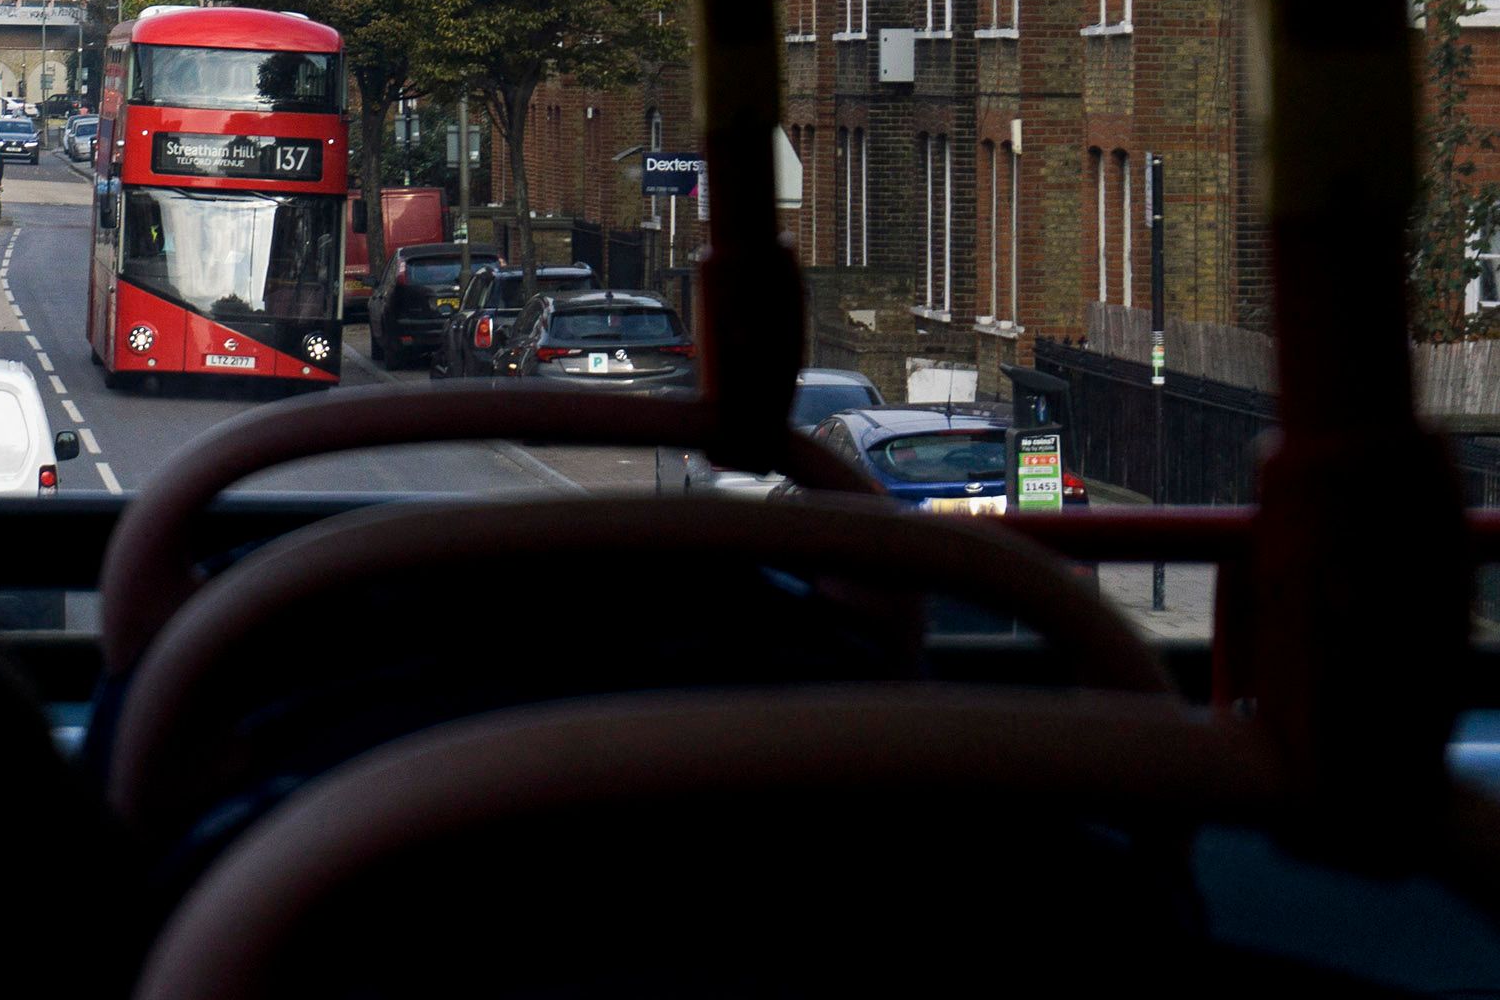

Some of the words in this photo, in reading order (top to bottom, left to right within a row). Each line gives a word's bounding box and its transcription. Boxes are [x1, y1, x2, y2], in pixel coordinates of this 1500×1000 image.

[166, 141, 229, 157] Streatham
[233, 145, 256, 159] Hill
[176, 156, 211, 167] TELFORD
[212, 157, 245, 168] AVENUE
[275, 146, 310, 171] 137
[646, 158, 700, 171] Dexters
[593, 357, 602, 367] P
[1026, 482, 1057, 491] 11453
